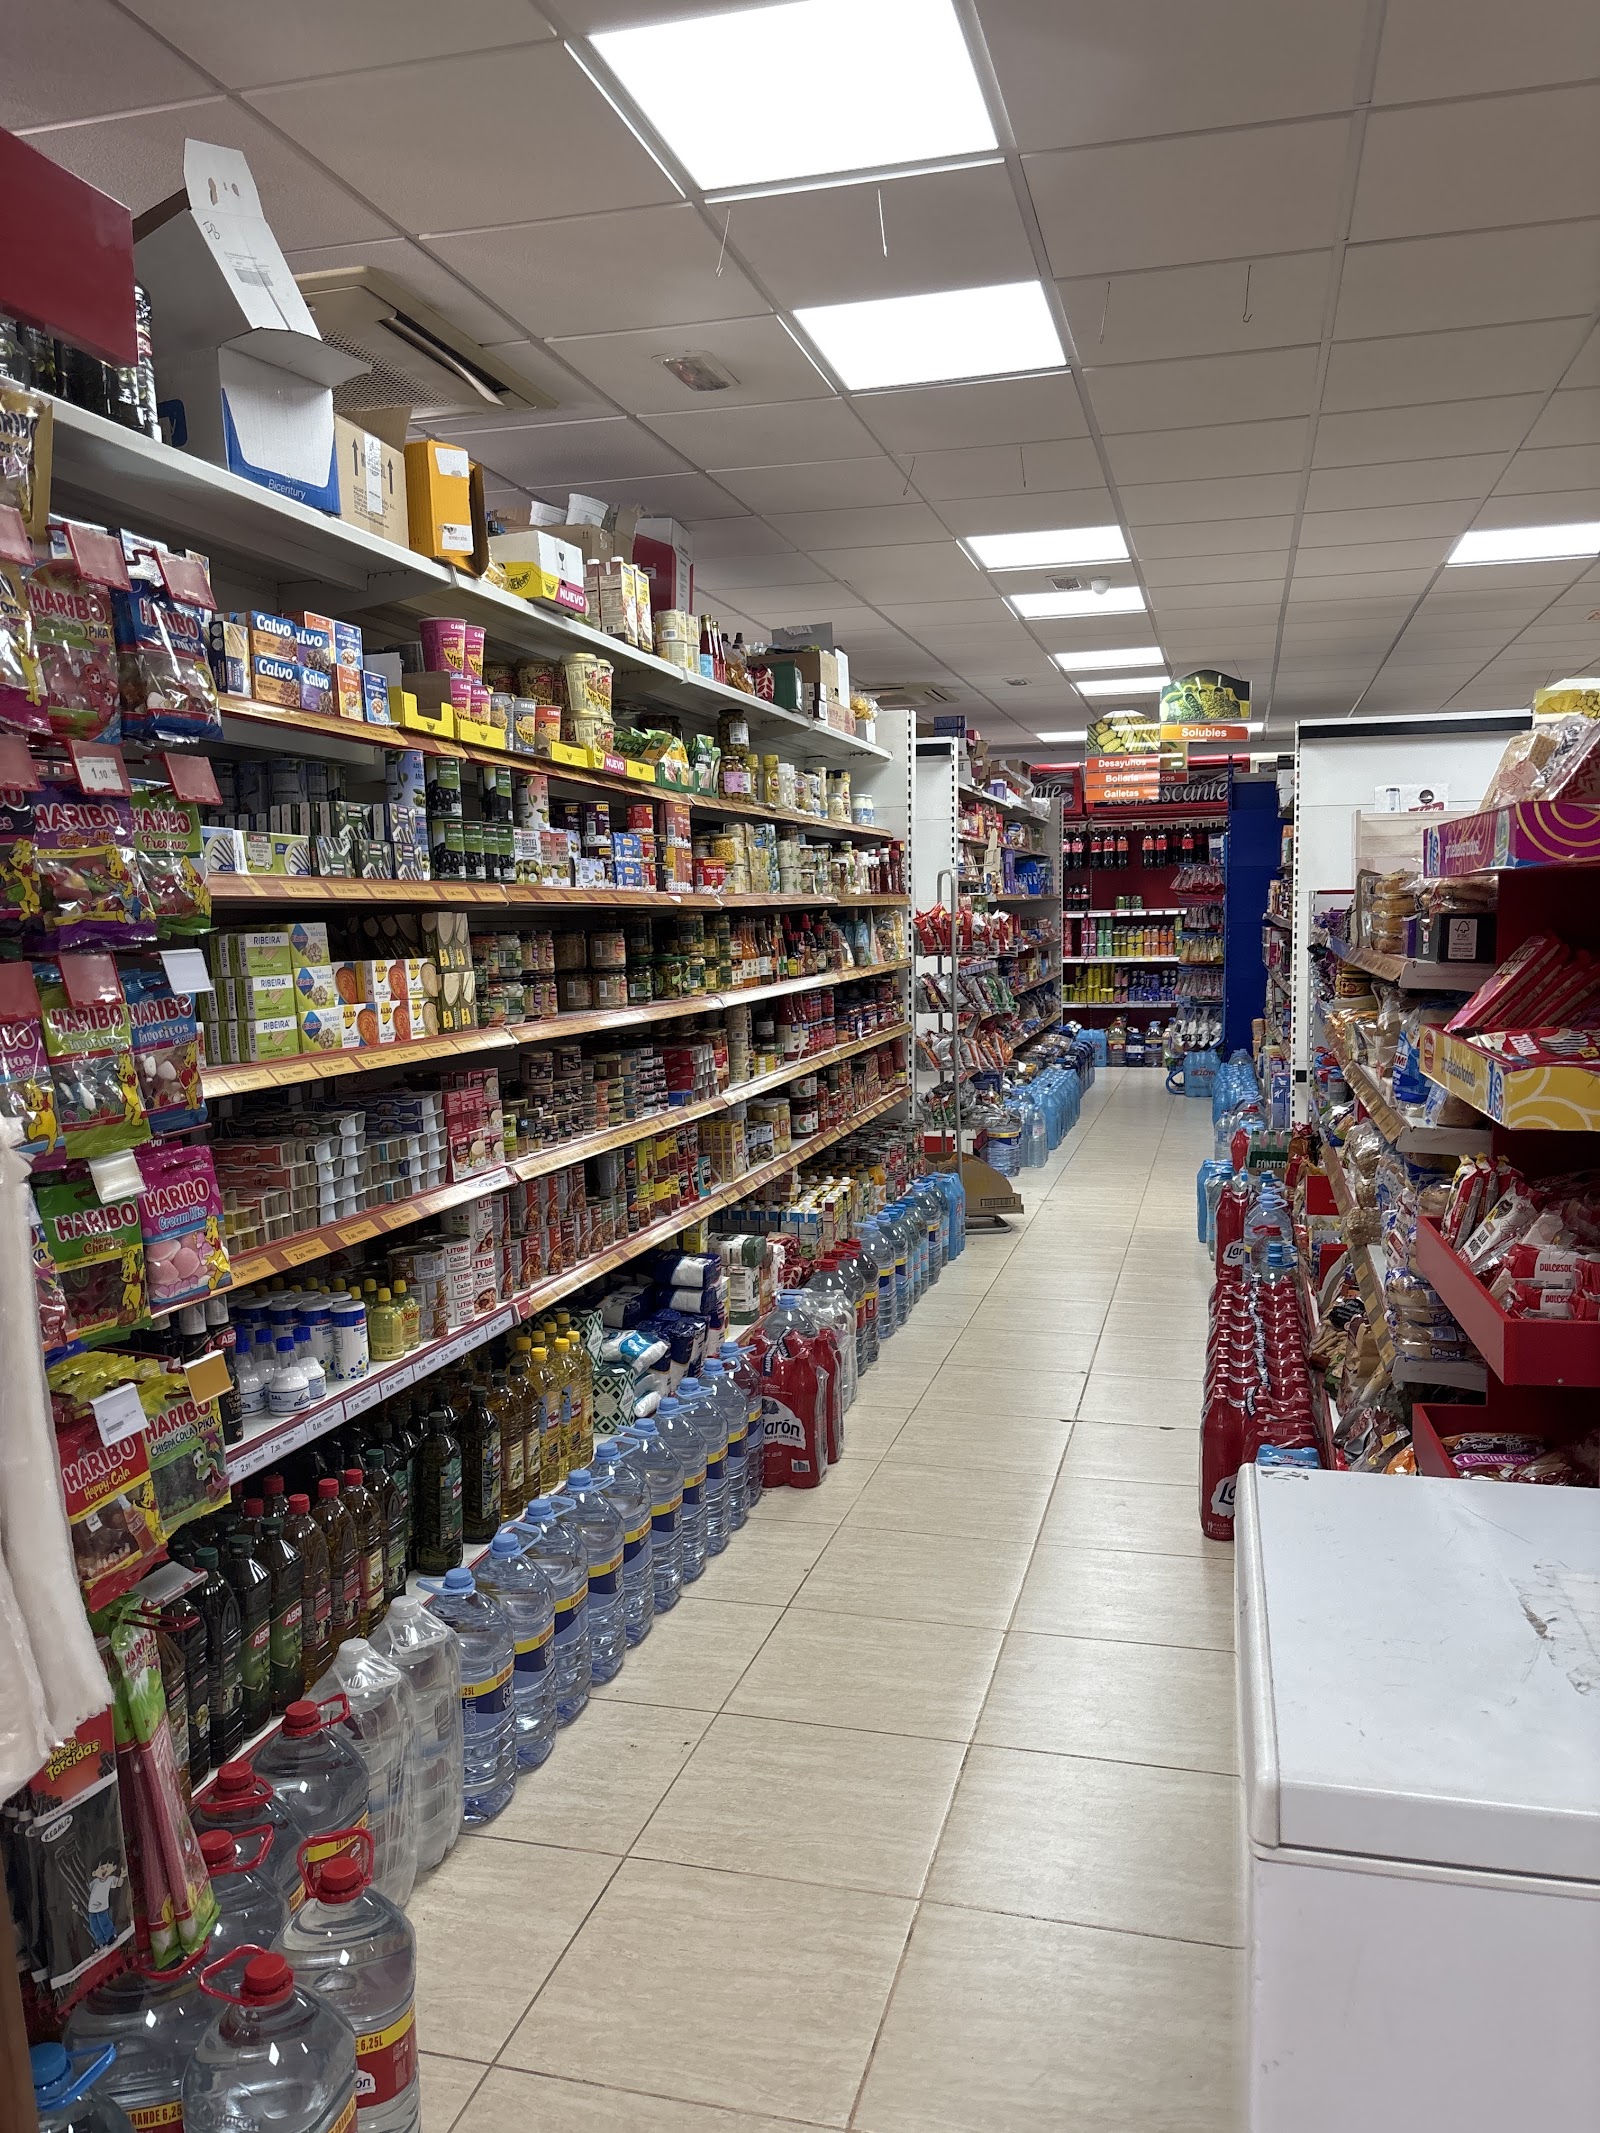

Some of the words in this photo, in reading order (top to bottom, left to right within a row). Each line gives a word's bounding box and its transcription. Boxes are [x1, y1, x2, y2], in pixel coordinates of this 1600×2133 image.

[267, 477, 306, 500] Bicentury
[28, 584, 107, 623] HARIBO
[559, 587, 585, 607] NUEVO
[140, 597, 200, 640] HRIBO
[256, 615, 292, 637] Calvo
[259, 658, 294, 680] Calvo
[303, 670, 329, 690] Calvo
[1181, 728, 1228, 738] Solubles
[605, 759, 625, 771] NUEVO
[1098, 759, 1147, 768] Desayunos
[1104, 790, 1139, 799] Galletas
[35, 802, 121, 831] HARIBO
[253, 936, 281, 945] RIBEIRA
[260, 978, 287, 987] RIBEIRA
[51, 1003, 124, 1035] HARIBO
[127, 994, 193, 1030] HARIBO
[138, 1022, 189, 1045] favoritos
[263, 1020, 290, 1030] RIBEIRA
[144, 1177, 210, 1218] HARIBO
[55, 1202, 138, 1242] HARIBO
[159, 1213, 190, 1230] Cream
[190, 1205, 208, 1221] Kiss
[446, 1244, 469, 1254] LITORAL
[145, 1402, 211, 1444] HARIBO
[763, 1418, 801, 1438] jarón
[151, 1437, 176, 1457] CHISPA
[175, 1428, 196, 1445] COLA
[62, 1435, 136, 1495] HARIBO
[461, 1686, 475, 1697] ,25L
[45, 1740, 101, 1783] Torcidas
[50, 1738, 78, 1764] Mega
[43, 1816, 73, 1842] REGALIZ
[361, 2037, 384, 2053] 6,25L
[162, 2102, 183, 2120] 6,25
